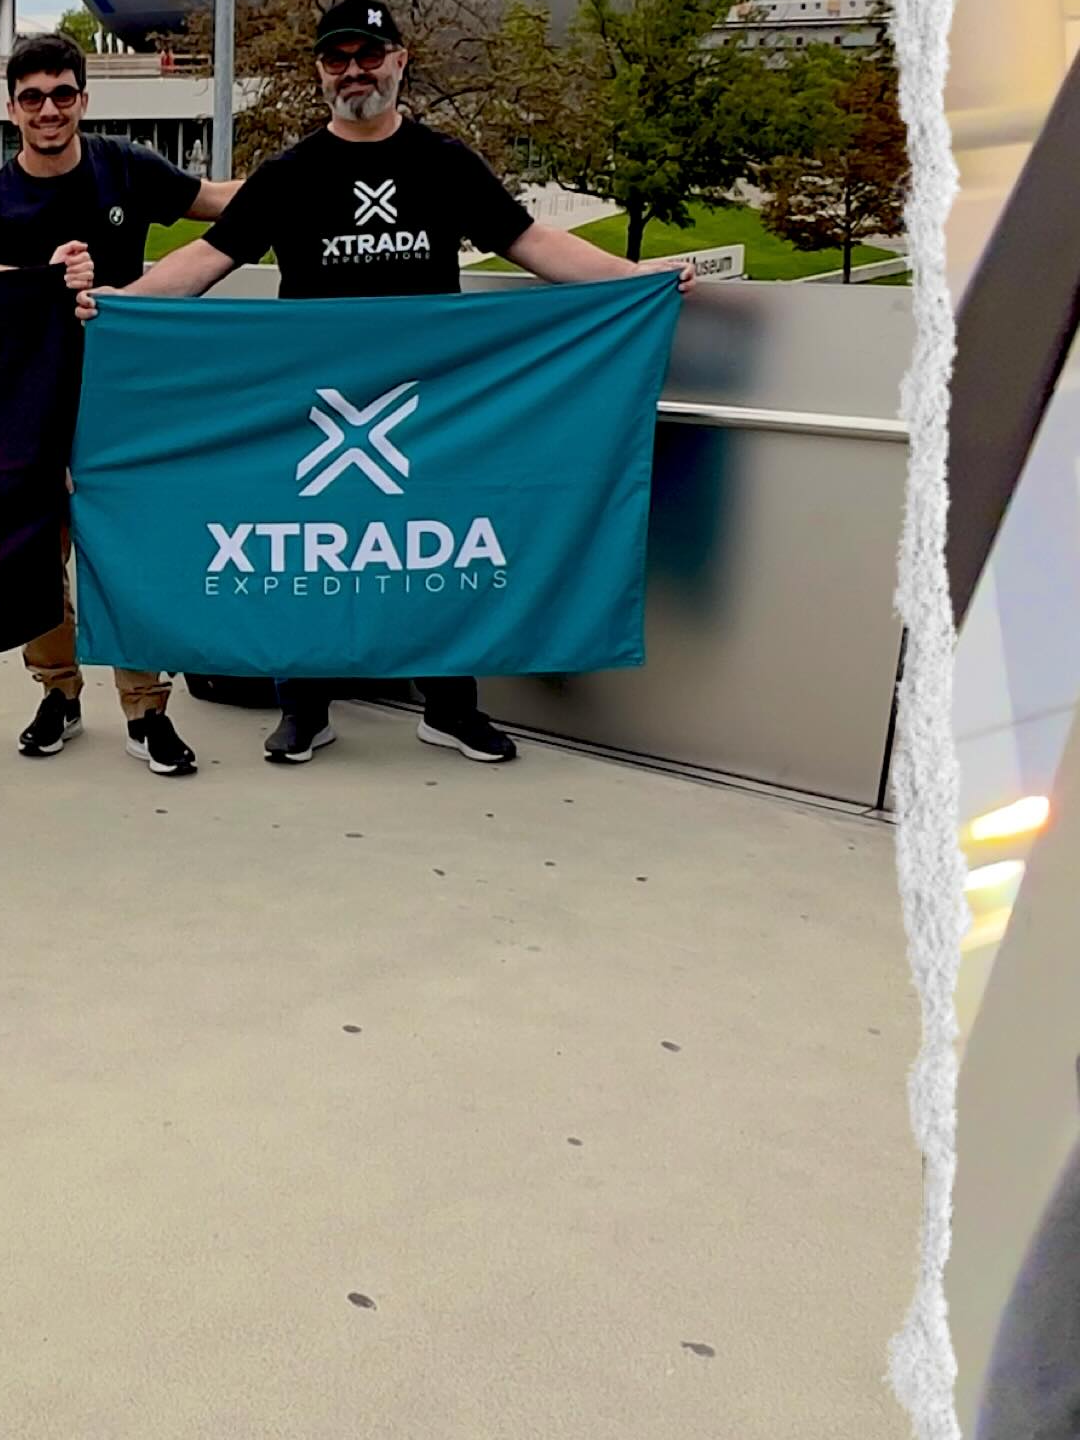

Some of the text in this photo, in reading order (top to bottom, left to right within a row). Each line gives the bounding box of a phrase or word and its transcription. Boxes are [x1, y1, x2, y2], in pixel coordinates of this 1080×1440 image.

[322, 230, 430, 257] XTRADA
[206, 517, 508, 573] XTRADA
[205, 569, 508, 596] EXPEDITIONS
